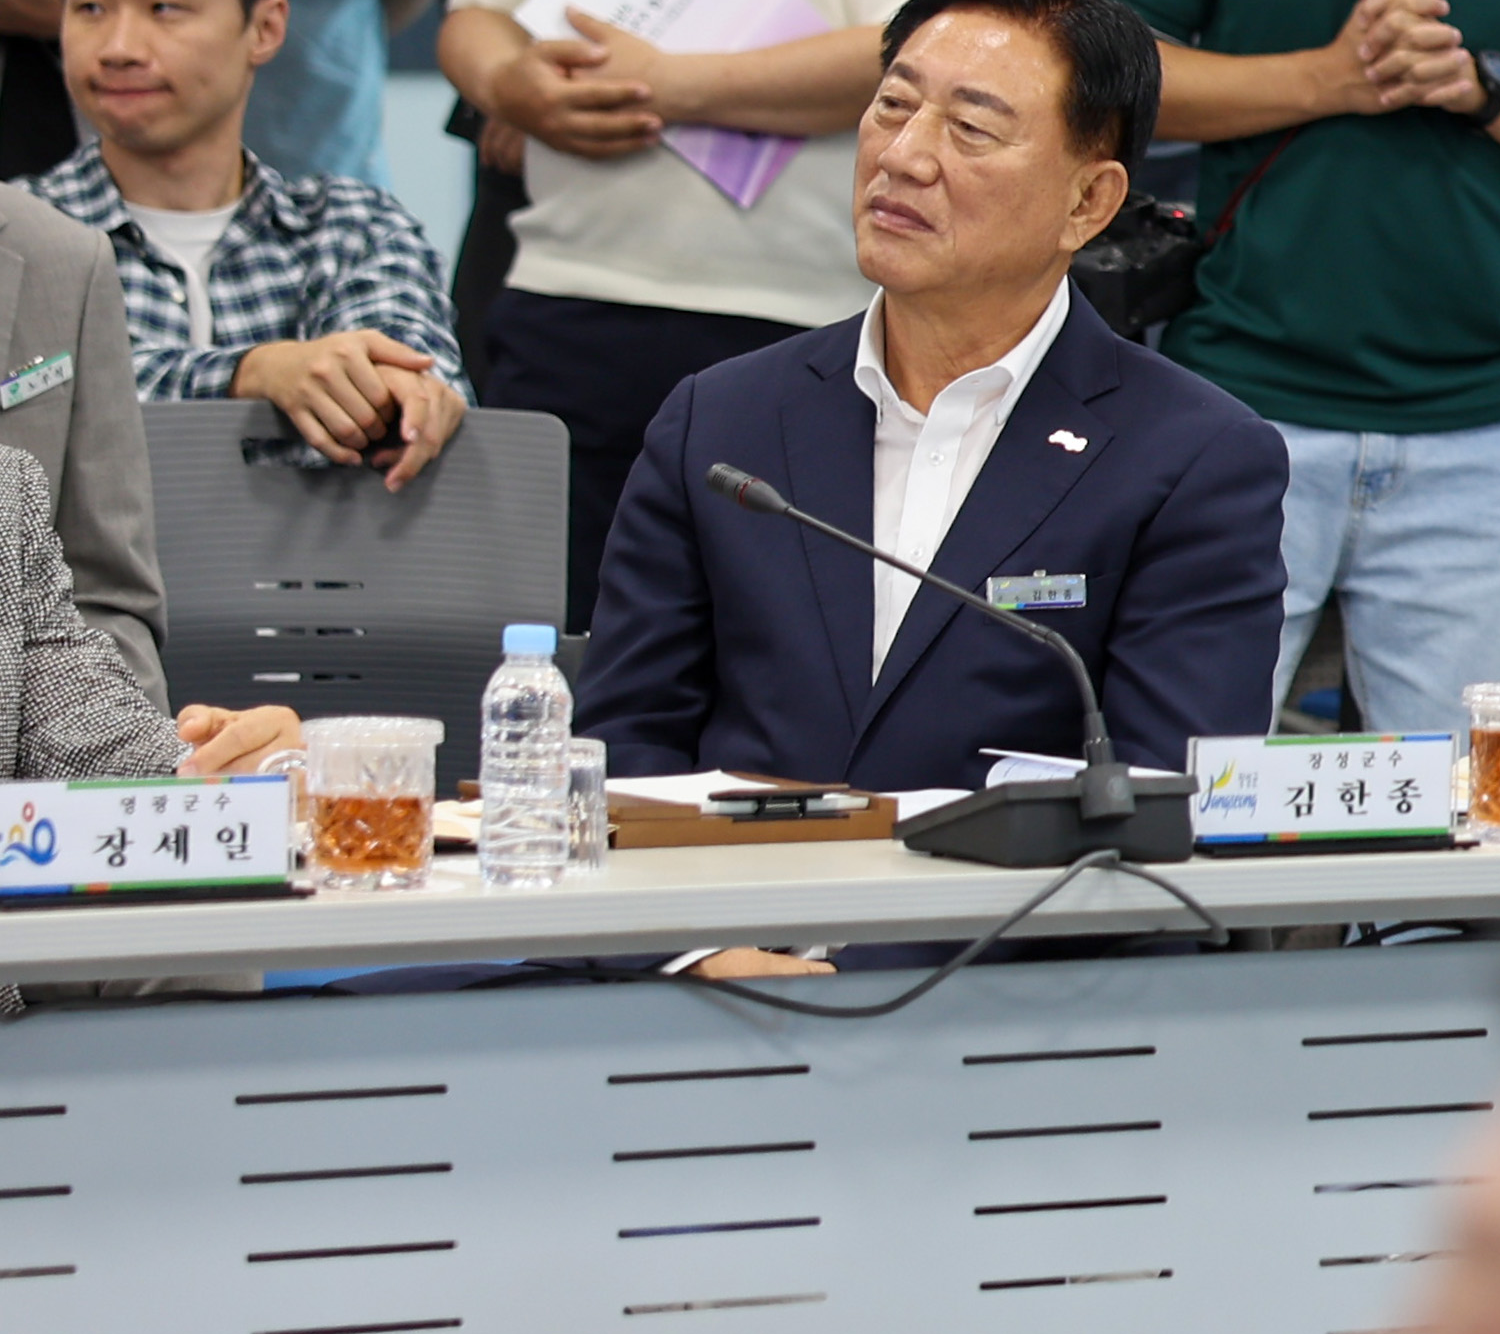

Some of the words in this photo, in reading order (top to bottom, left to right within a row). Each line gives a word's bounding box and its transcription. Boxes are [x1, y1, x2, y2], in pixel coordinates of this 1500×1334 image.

[1308, 749, 1403, 770] 장성군수
[120, 791, 232, 814] 영광군수
[1284, 777, 1422, 818] 김한종
[93, 823, 252, 867] 장세일
